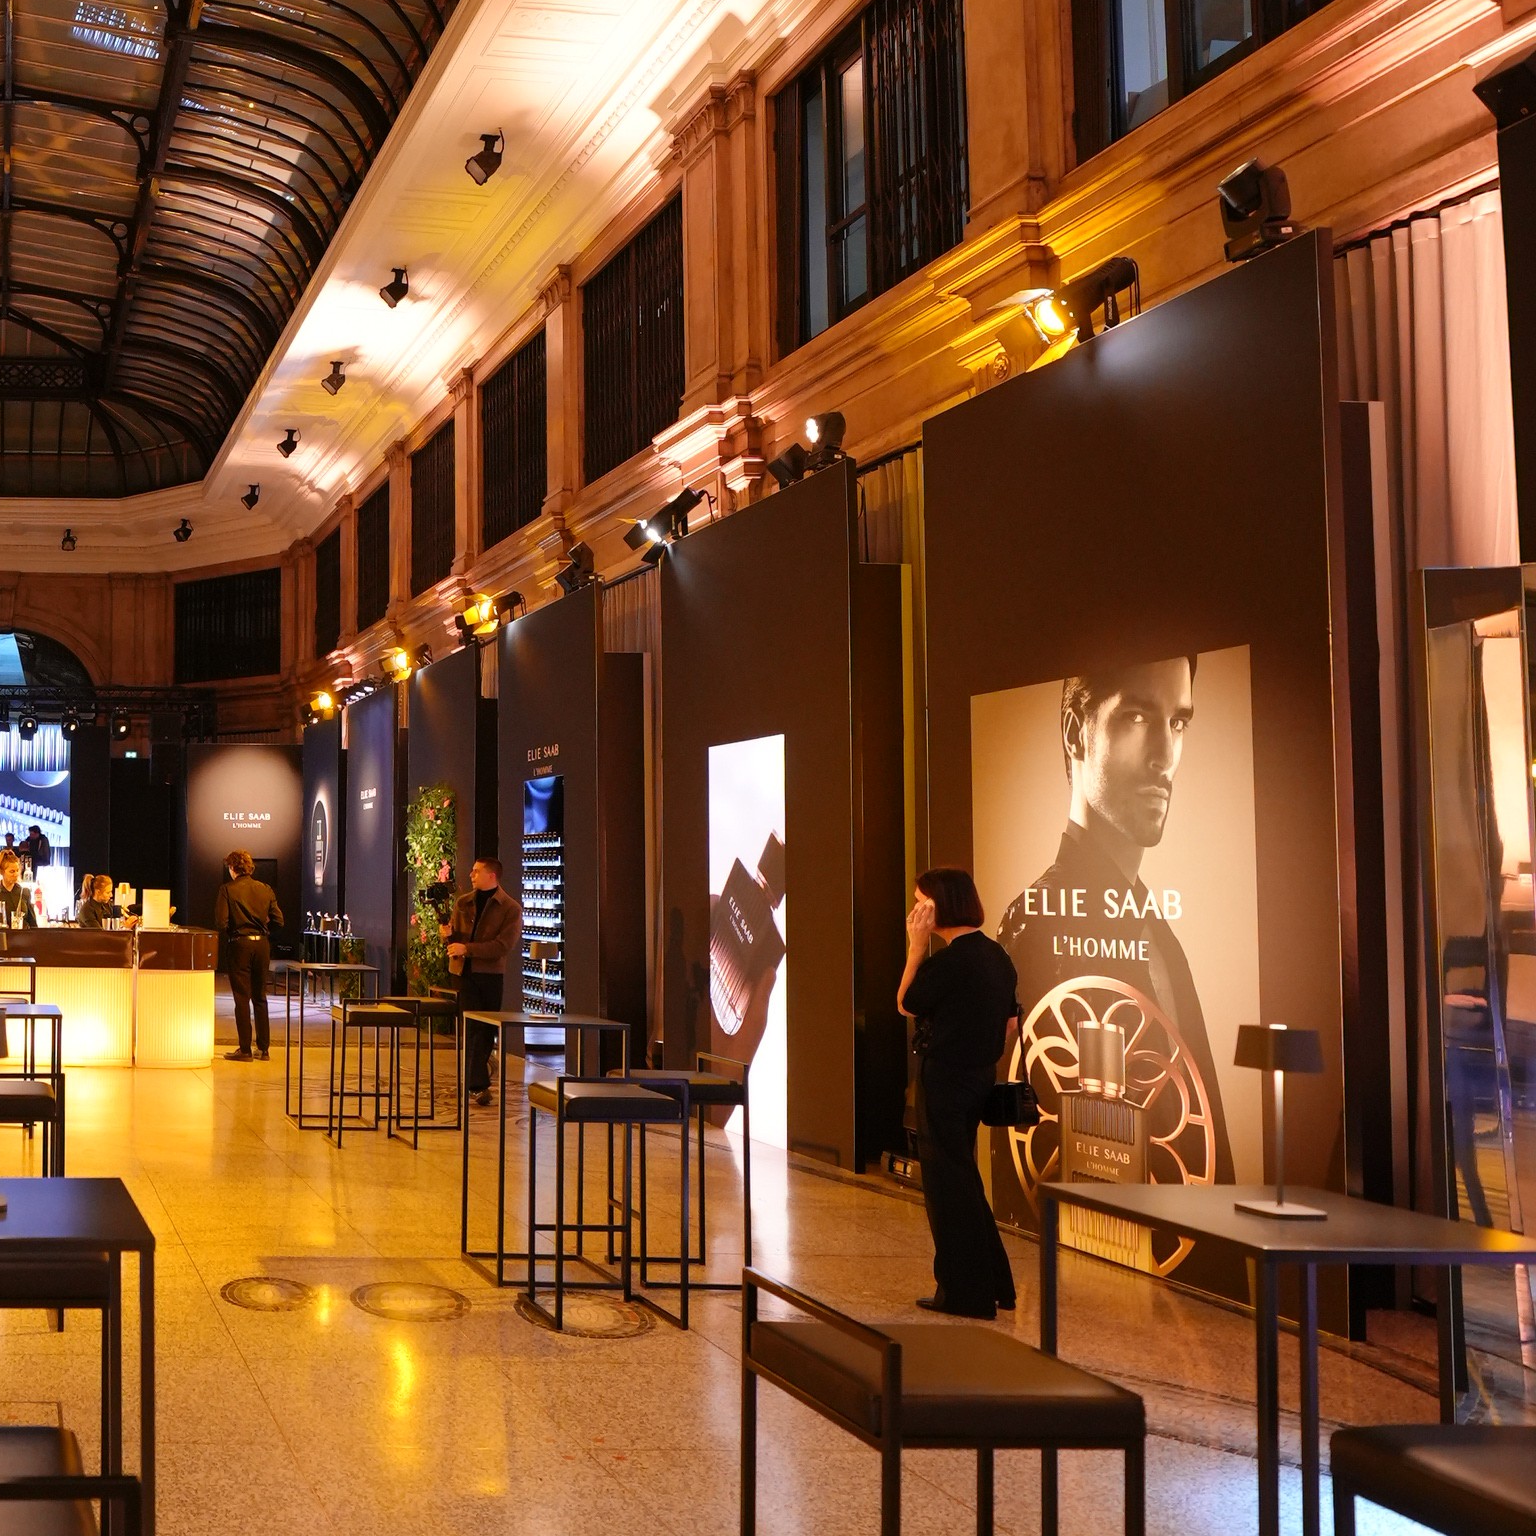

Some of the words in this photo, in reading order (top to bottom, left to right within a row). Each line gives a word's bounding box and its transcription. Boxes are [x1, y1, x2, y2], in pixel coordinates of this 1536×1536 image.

[527, 747, 541, 762] ELIE
[544, 743, 560, 759] SAAB
[223, 812, 245, 820] ELIE
[248, 812, 271, 821] SAAB
[1024, 888, 1087, 917] ELIE
[1103, 888, 1183, 920] SAAB
[1052, 935, 1150, 961] L'HOMME
[1075, 1141, 1100, 1157] ELIE
[1104, 1148, 1131, 1165] SAAB
[1086, 1160, 1120, 1177] L'HOMME
